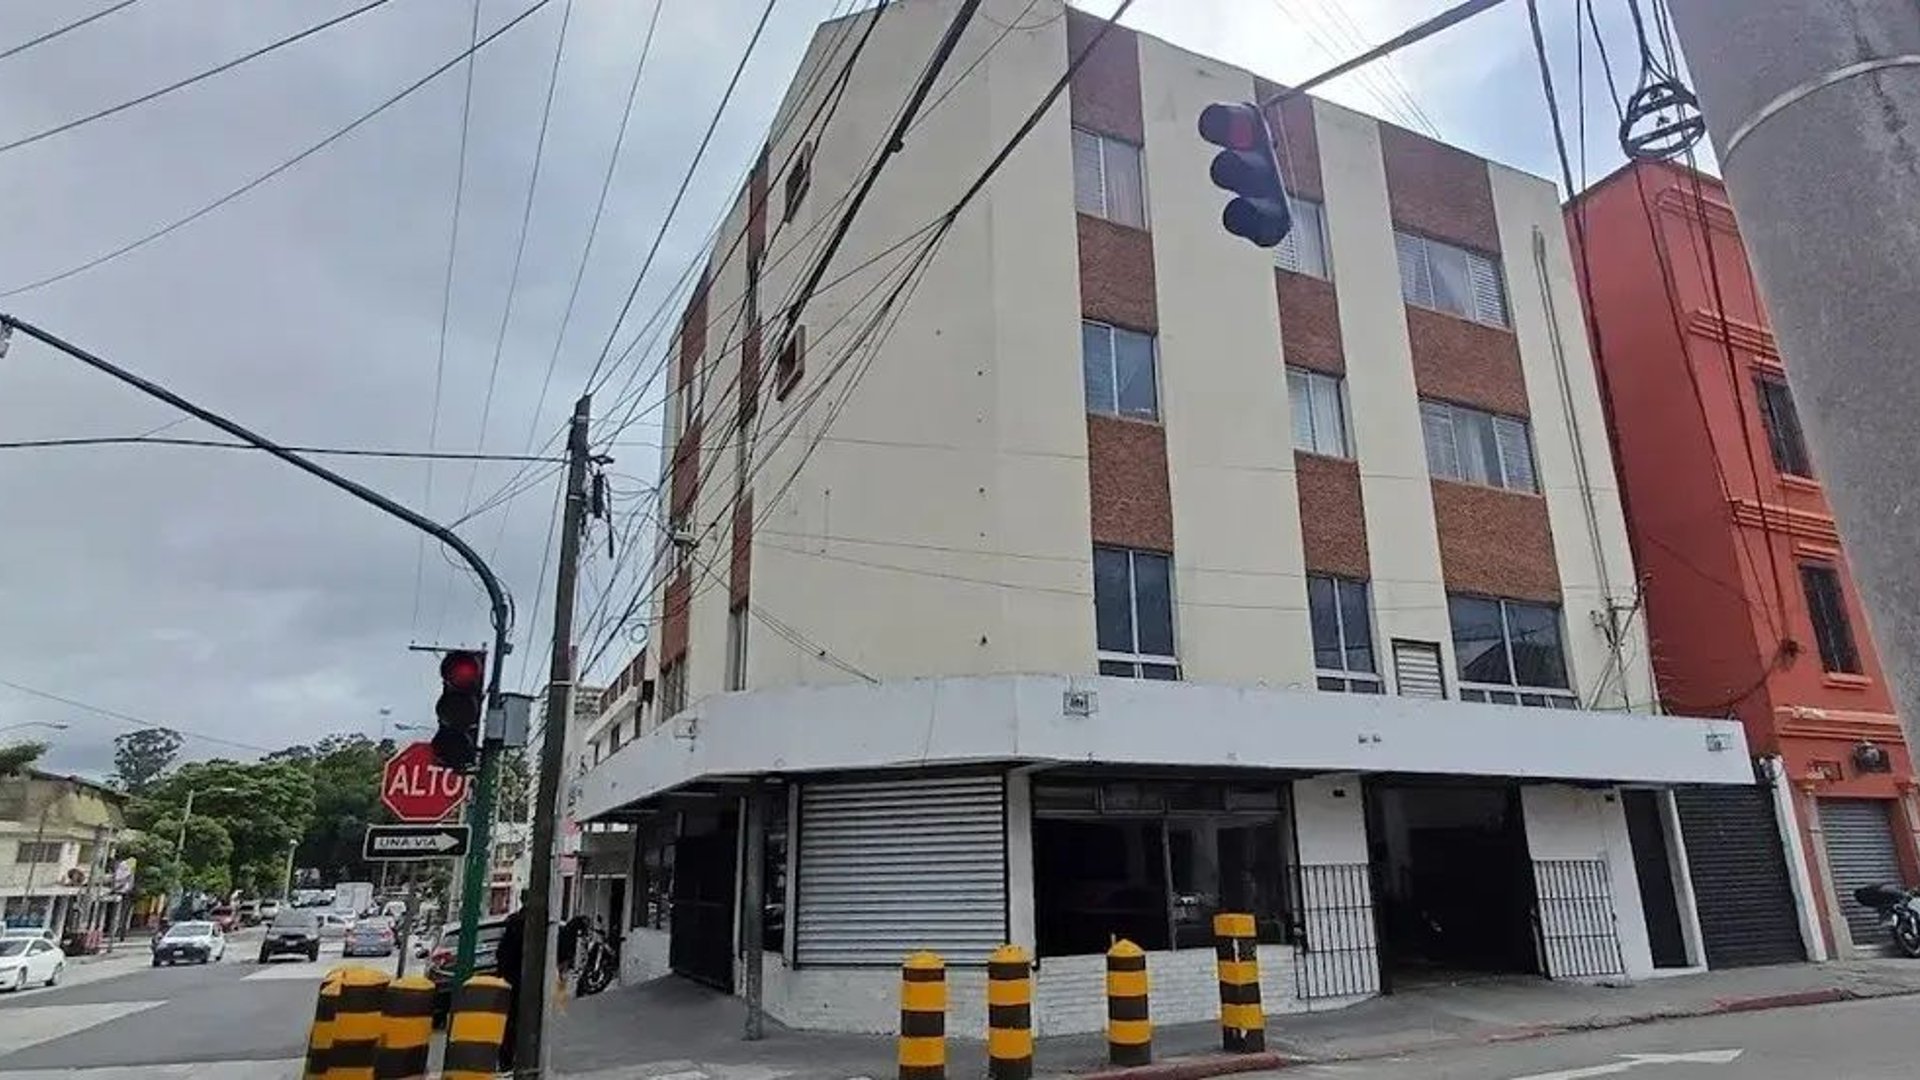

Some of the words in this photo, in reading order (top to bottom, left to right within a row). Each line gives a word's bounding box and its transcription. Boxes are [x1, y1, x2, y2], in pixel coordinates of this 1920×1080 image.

[388, 765, 463, 796] ALTO
[379, 836, 408, 847] UNA
[415, 836, 437, 847] VIA
